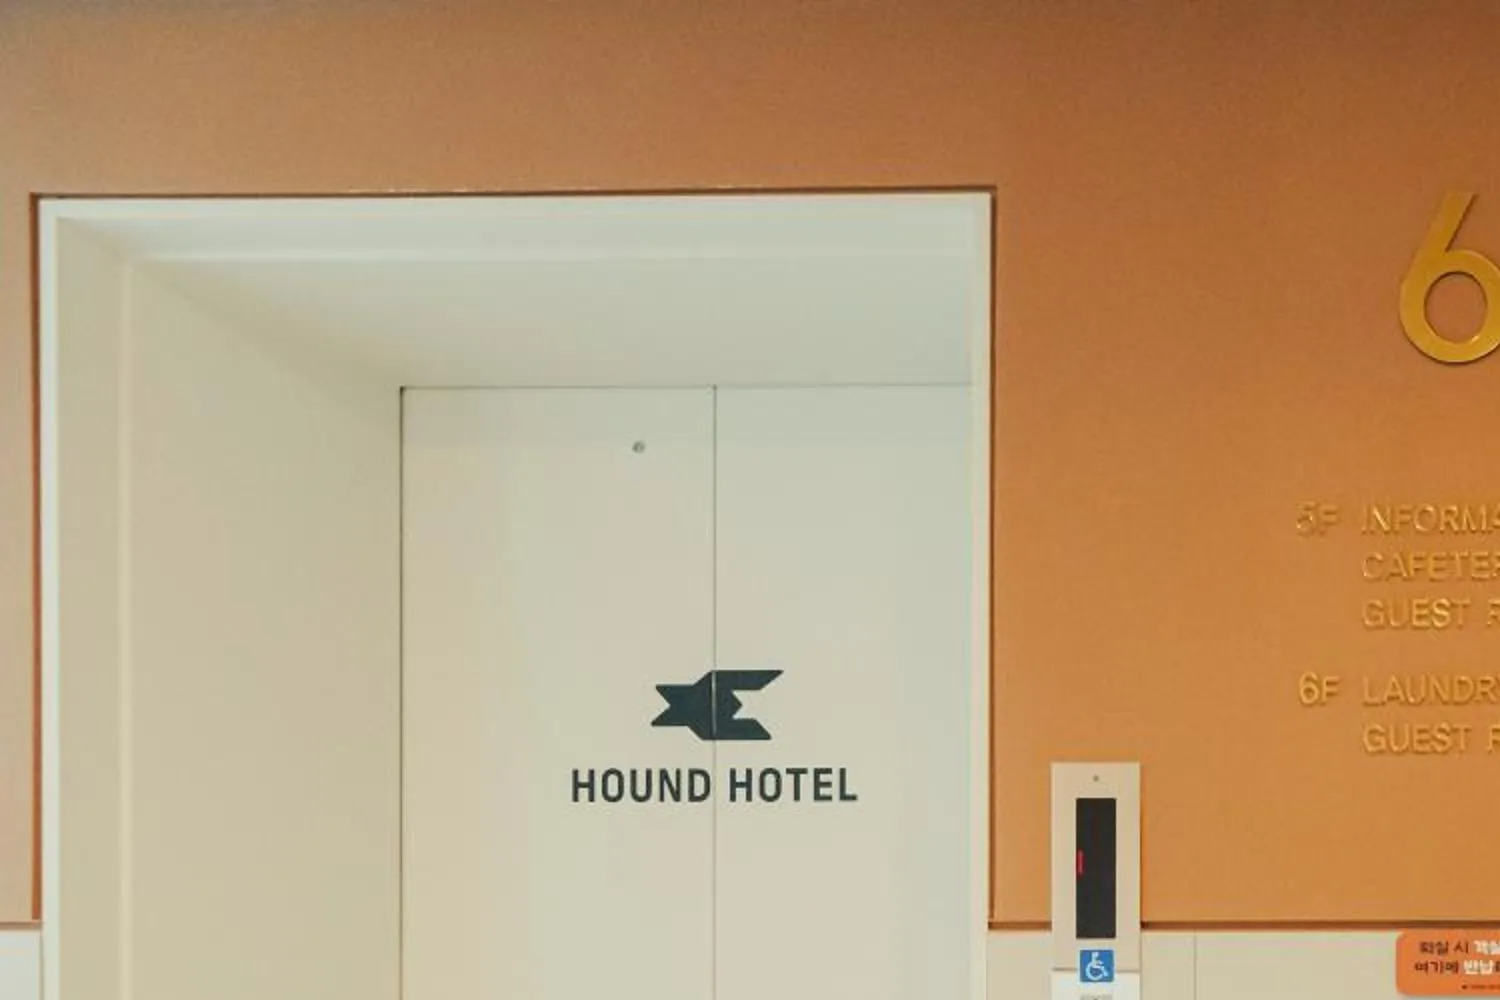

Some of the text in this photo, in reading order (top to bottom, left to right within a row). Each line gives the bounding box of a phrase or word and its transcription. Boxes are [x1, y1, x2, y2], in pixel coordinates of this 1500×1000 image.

[1296, 501, 1341, 535] 5F
[1361, 598, 1471, 630] GUEST
[1298, 671, 1341, 707] 6F
[1361, 723, 1472, 755] GUEST
[571, 768, 858, 803] HOUND HOTEL
[1454, 940, 1470, 954] 시
[1414, 960, 1459, 974] 여기에
